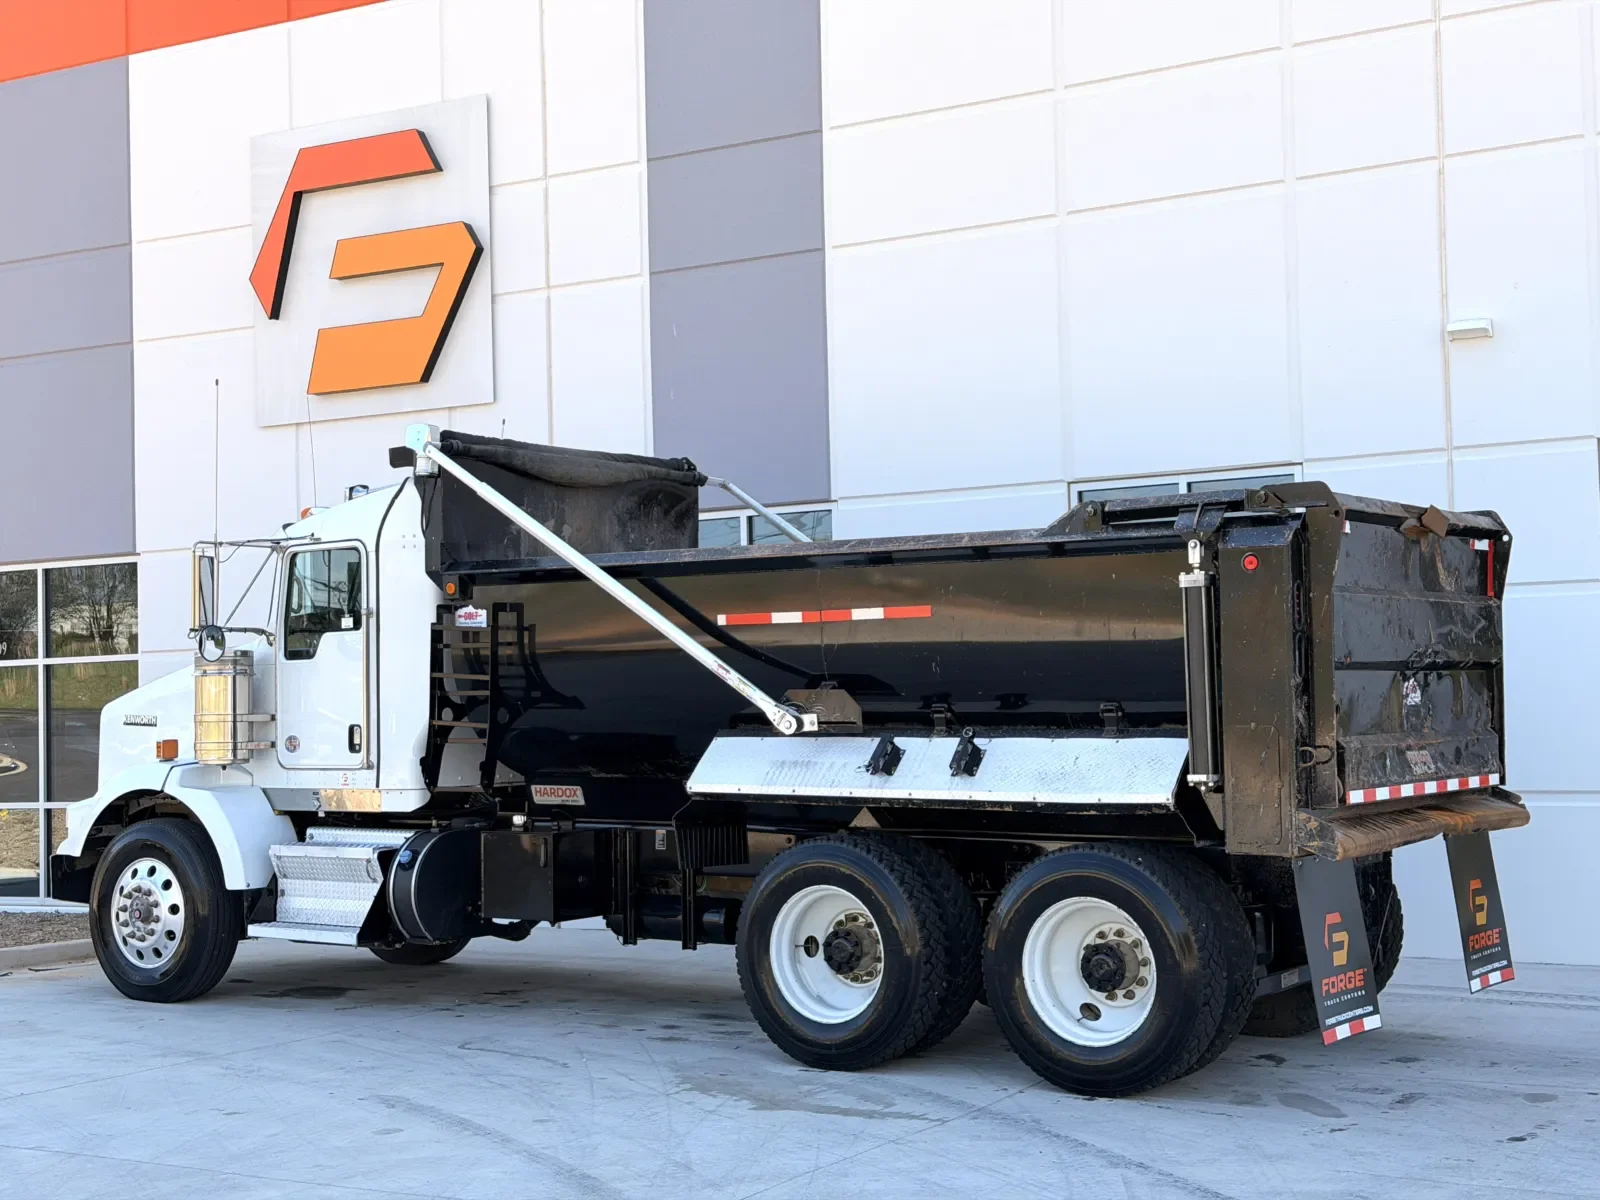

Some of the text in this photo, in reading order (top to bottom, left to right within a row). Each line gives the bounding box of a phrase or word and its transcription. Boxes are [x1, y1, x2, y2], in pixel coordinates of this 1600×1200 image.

[0, 641, 7, 656] 9
[123, 714, 158, 727] KENWORTH
[535, 786, 579, 799] HARDOX
[1469, 928, 1501, 952] FORGE
[1322, 968, 1365, 997] FORGE
